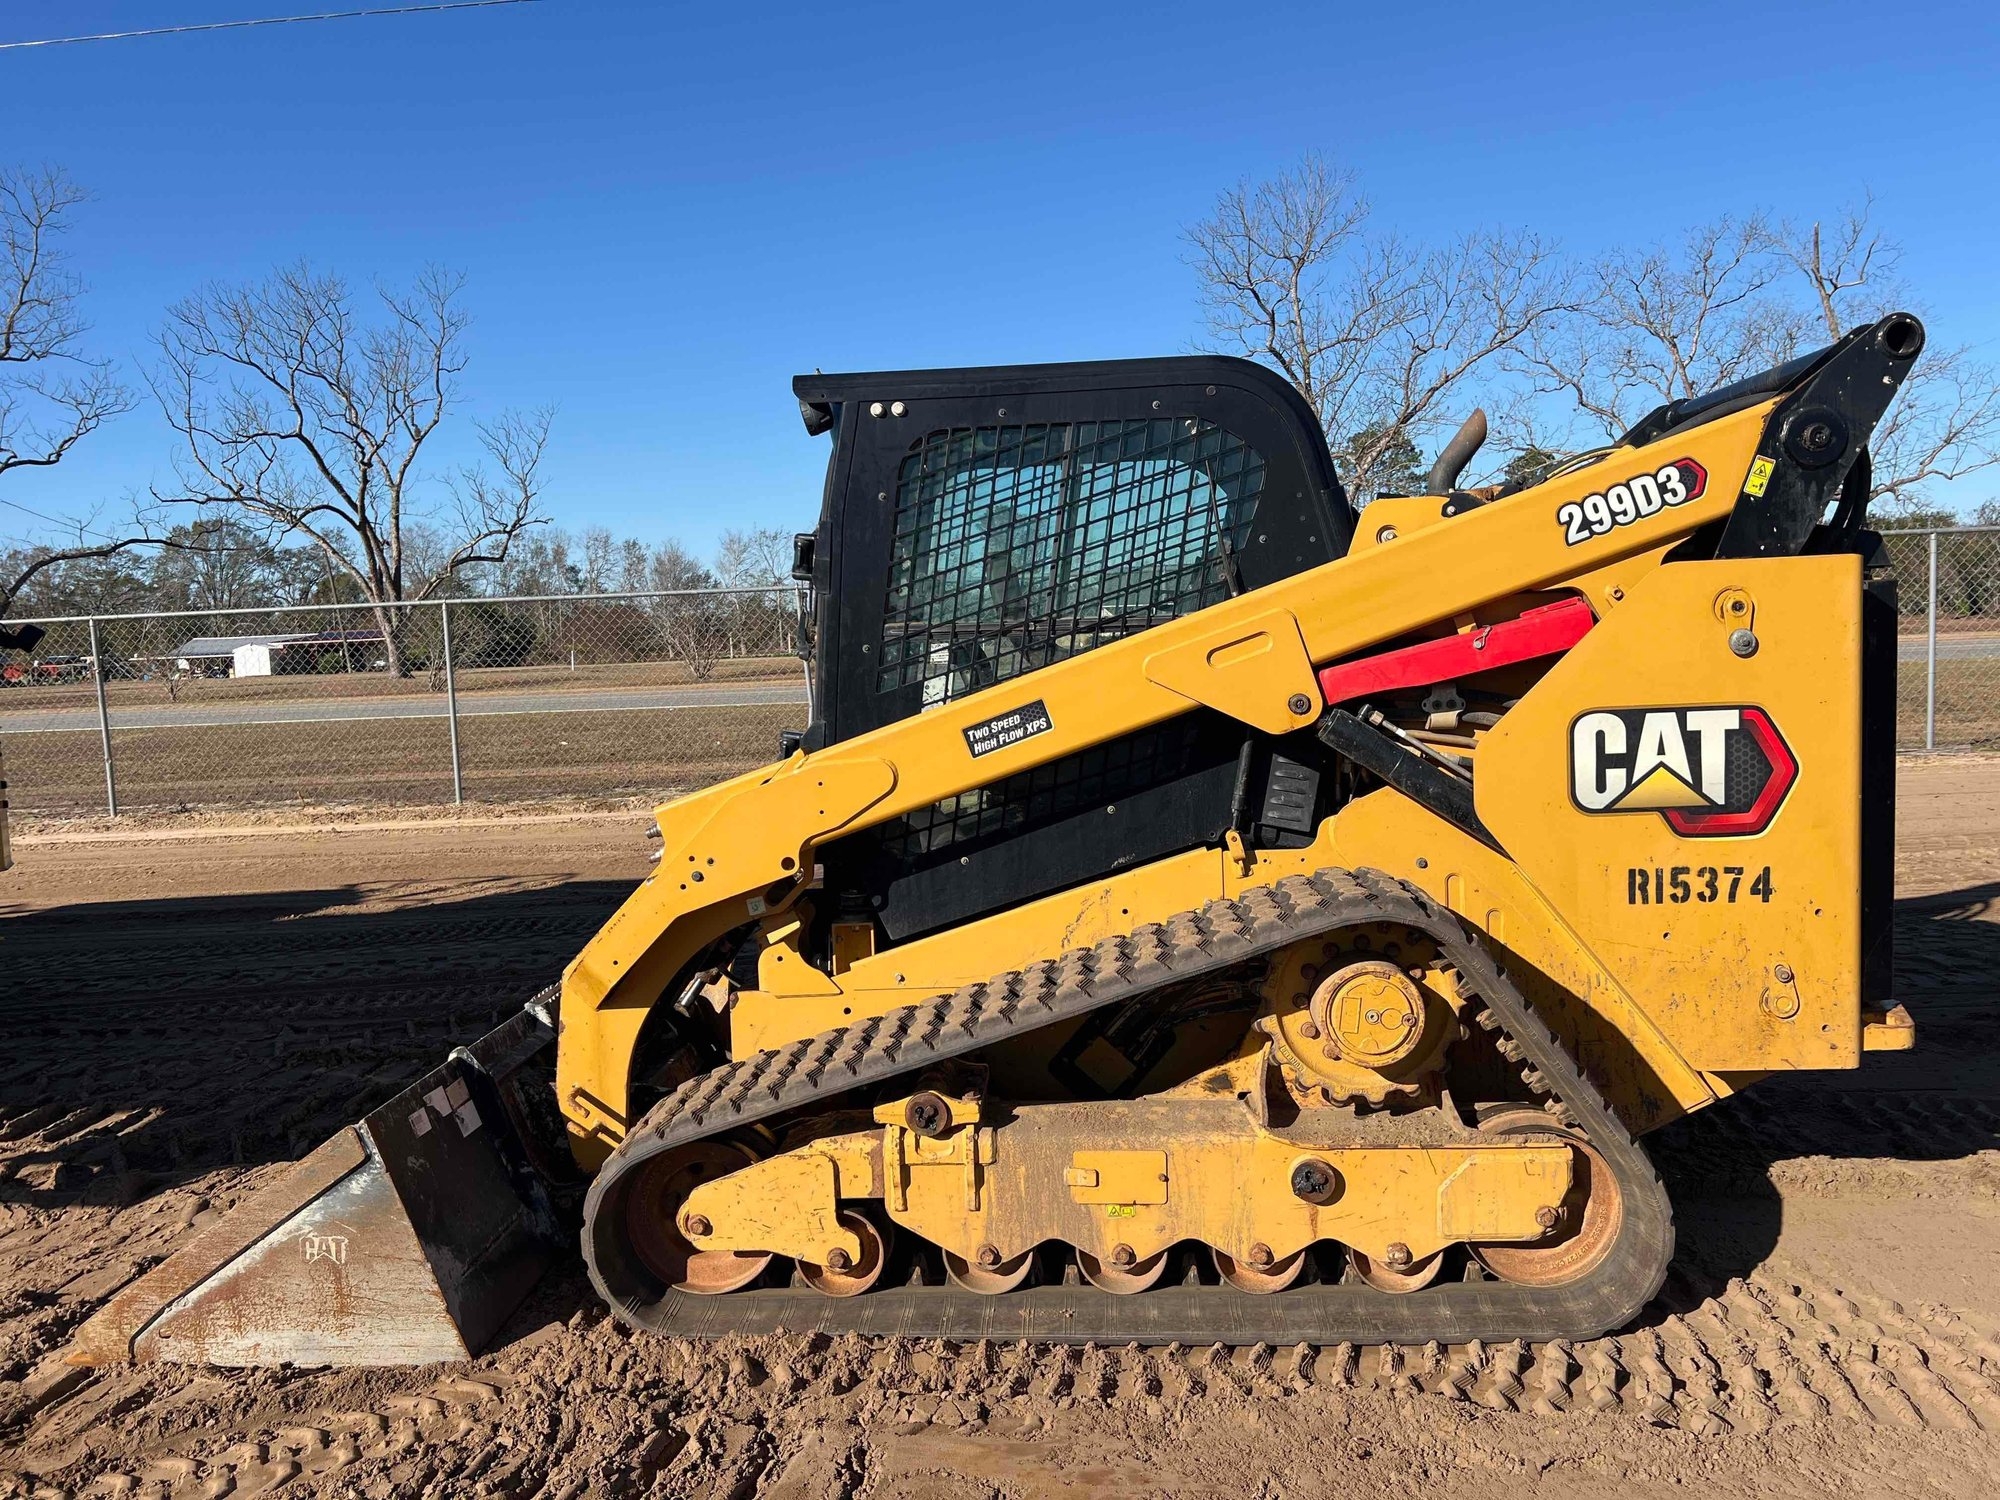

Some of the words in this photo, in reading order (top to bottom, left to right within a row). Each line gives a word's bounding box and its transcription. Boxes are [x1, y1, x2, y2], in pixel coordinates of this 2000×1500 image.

[1558, 466, 1687, 544] 299D3
[1025, 717, 1047, 734] XPS
[1573, 709, 1740, 810] CAT
[299, 1234, 348, 1265] CAT
